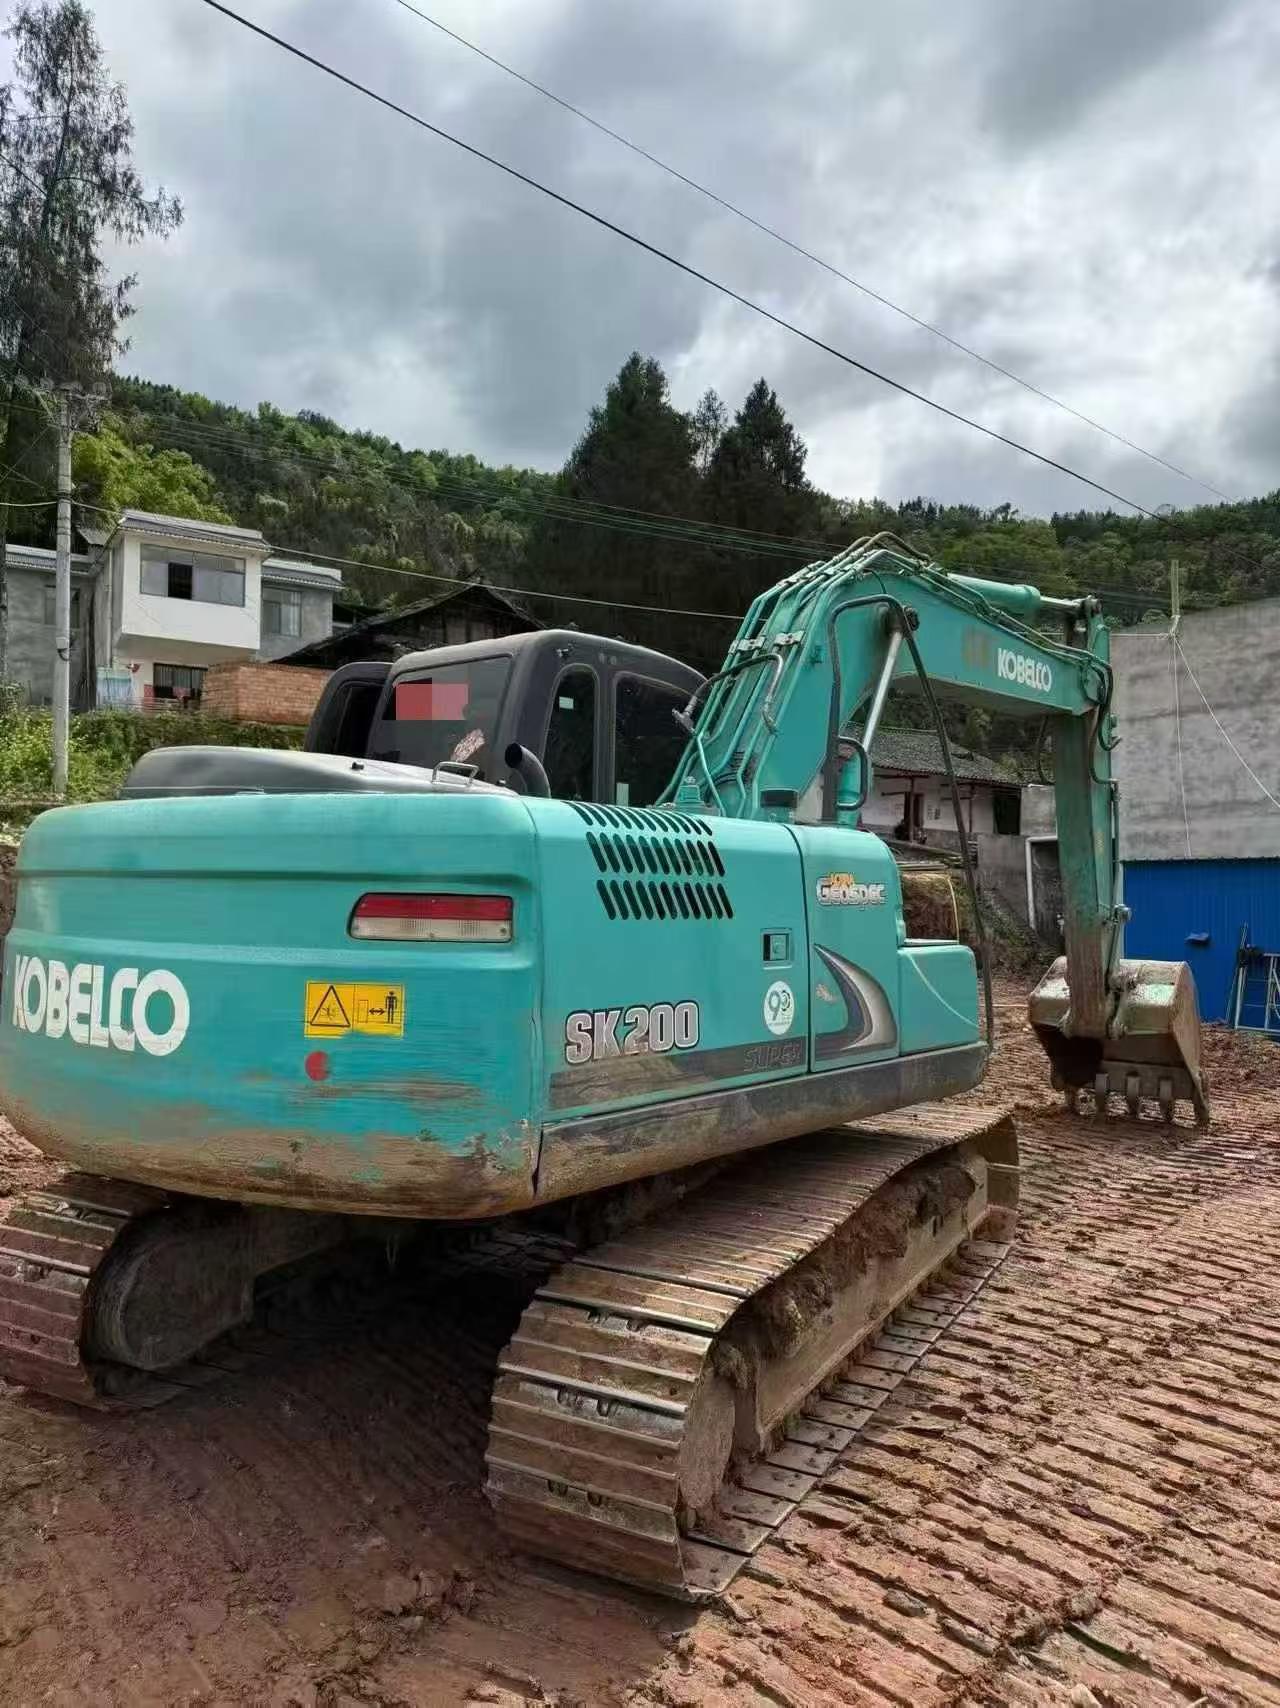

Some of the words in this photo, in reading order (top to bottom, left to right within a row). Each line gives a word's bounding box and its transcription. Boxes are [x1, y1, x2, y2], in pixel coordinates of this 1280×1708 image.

[998, 649, 1052, 692] KOBELCO
[13, 955, 190, 1056] KOBELCO
[565, 1000, 700, 1063] SK200
